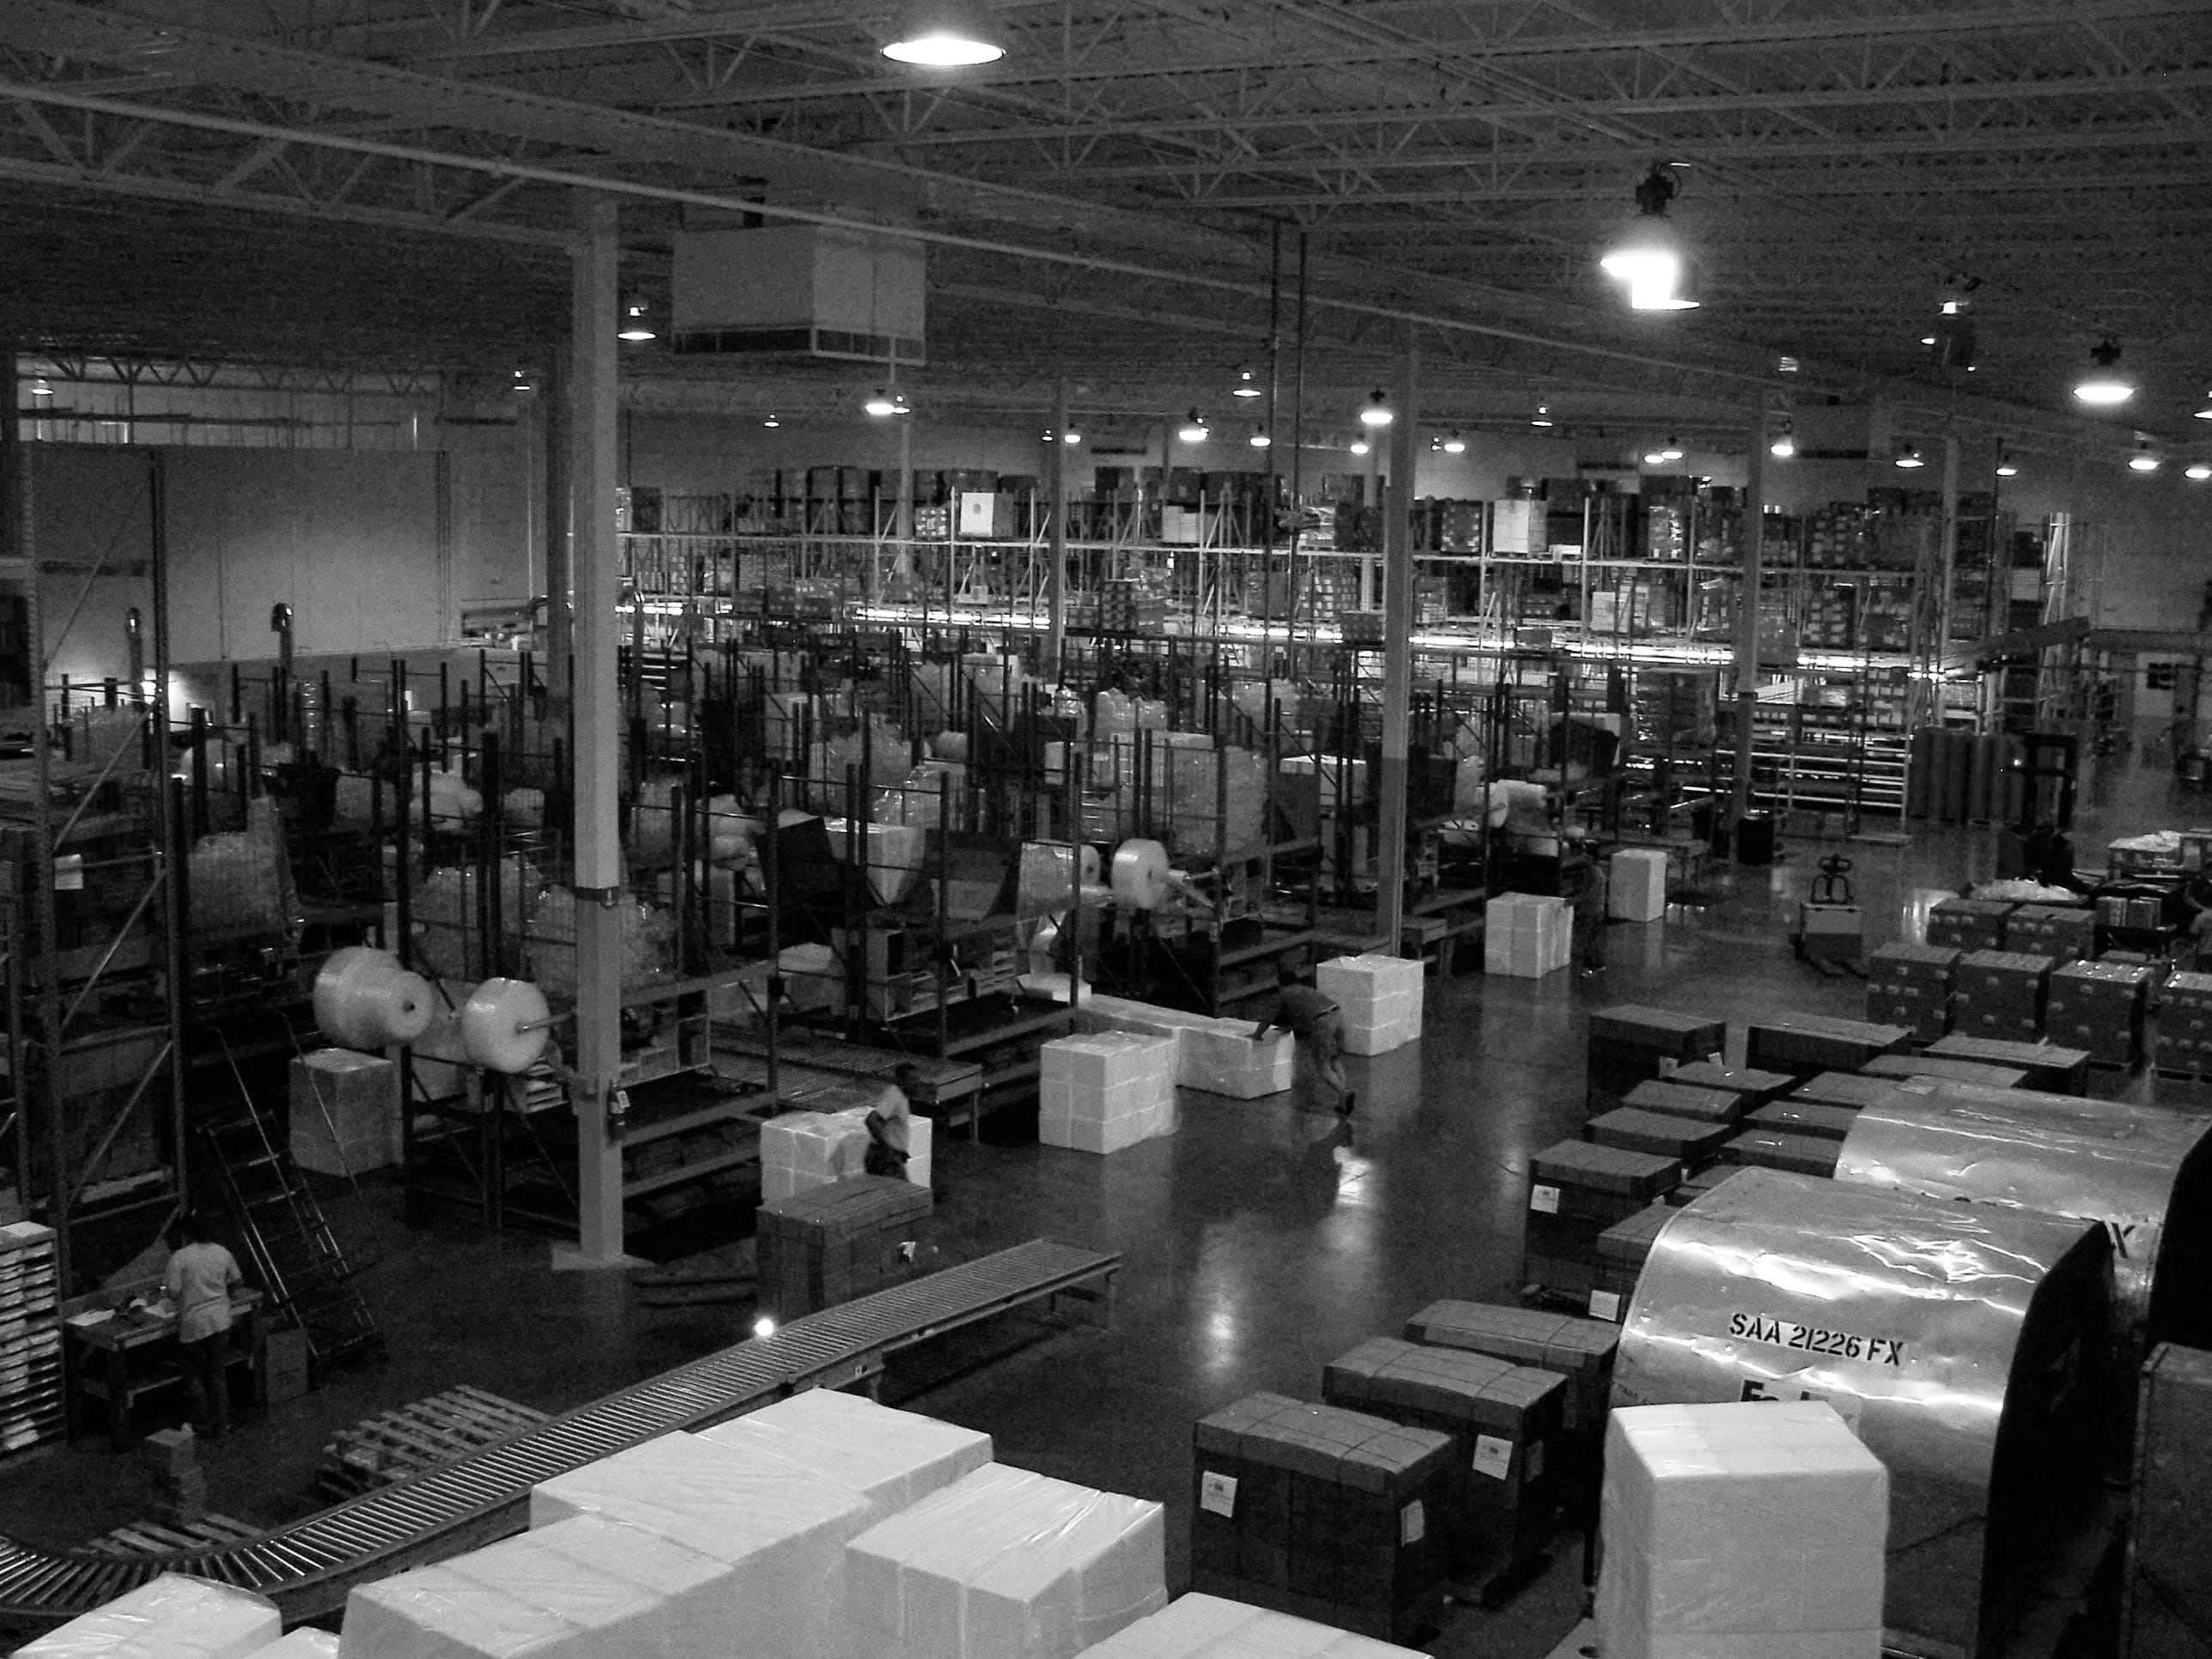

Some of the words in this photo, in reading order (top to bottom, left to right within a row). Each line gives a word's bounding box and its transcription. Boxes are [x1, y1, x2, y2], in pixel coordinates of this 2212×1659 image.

[1730, 1313, 1780, 1344] SAA
[1788, 1326, 1861, 1358] 21226
[1867, 1337, 1904, 1366] FX
